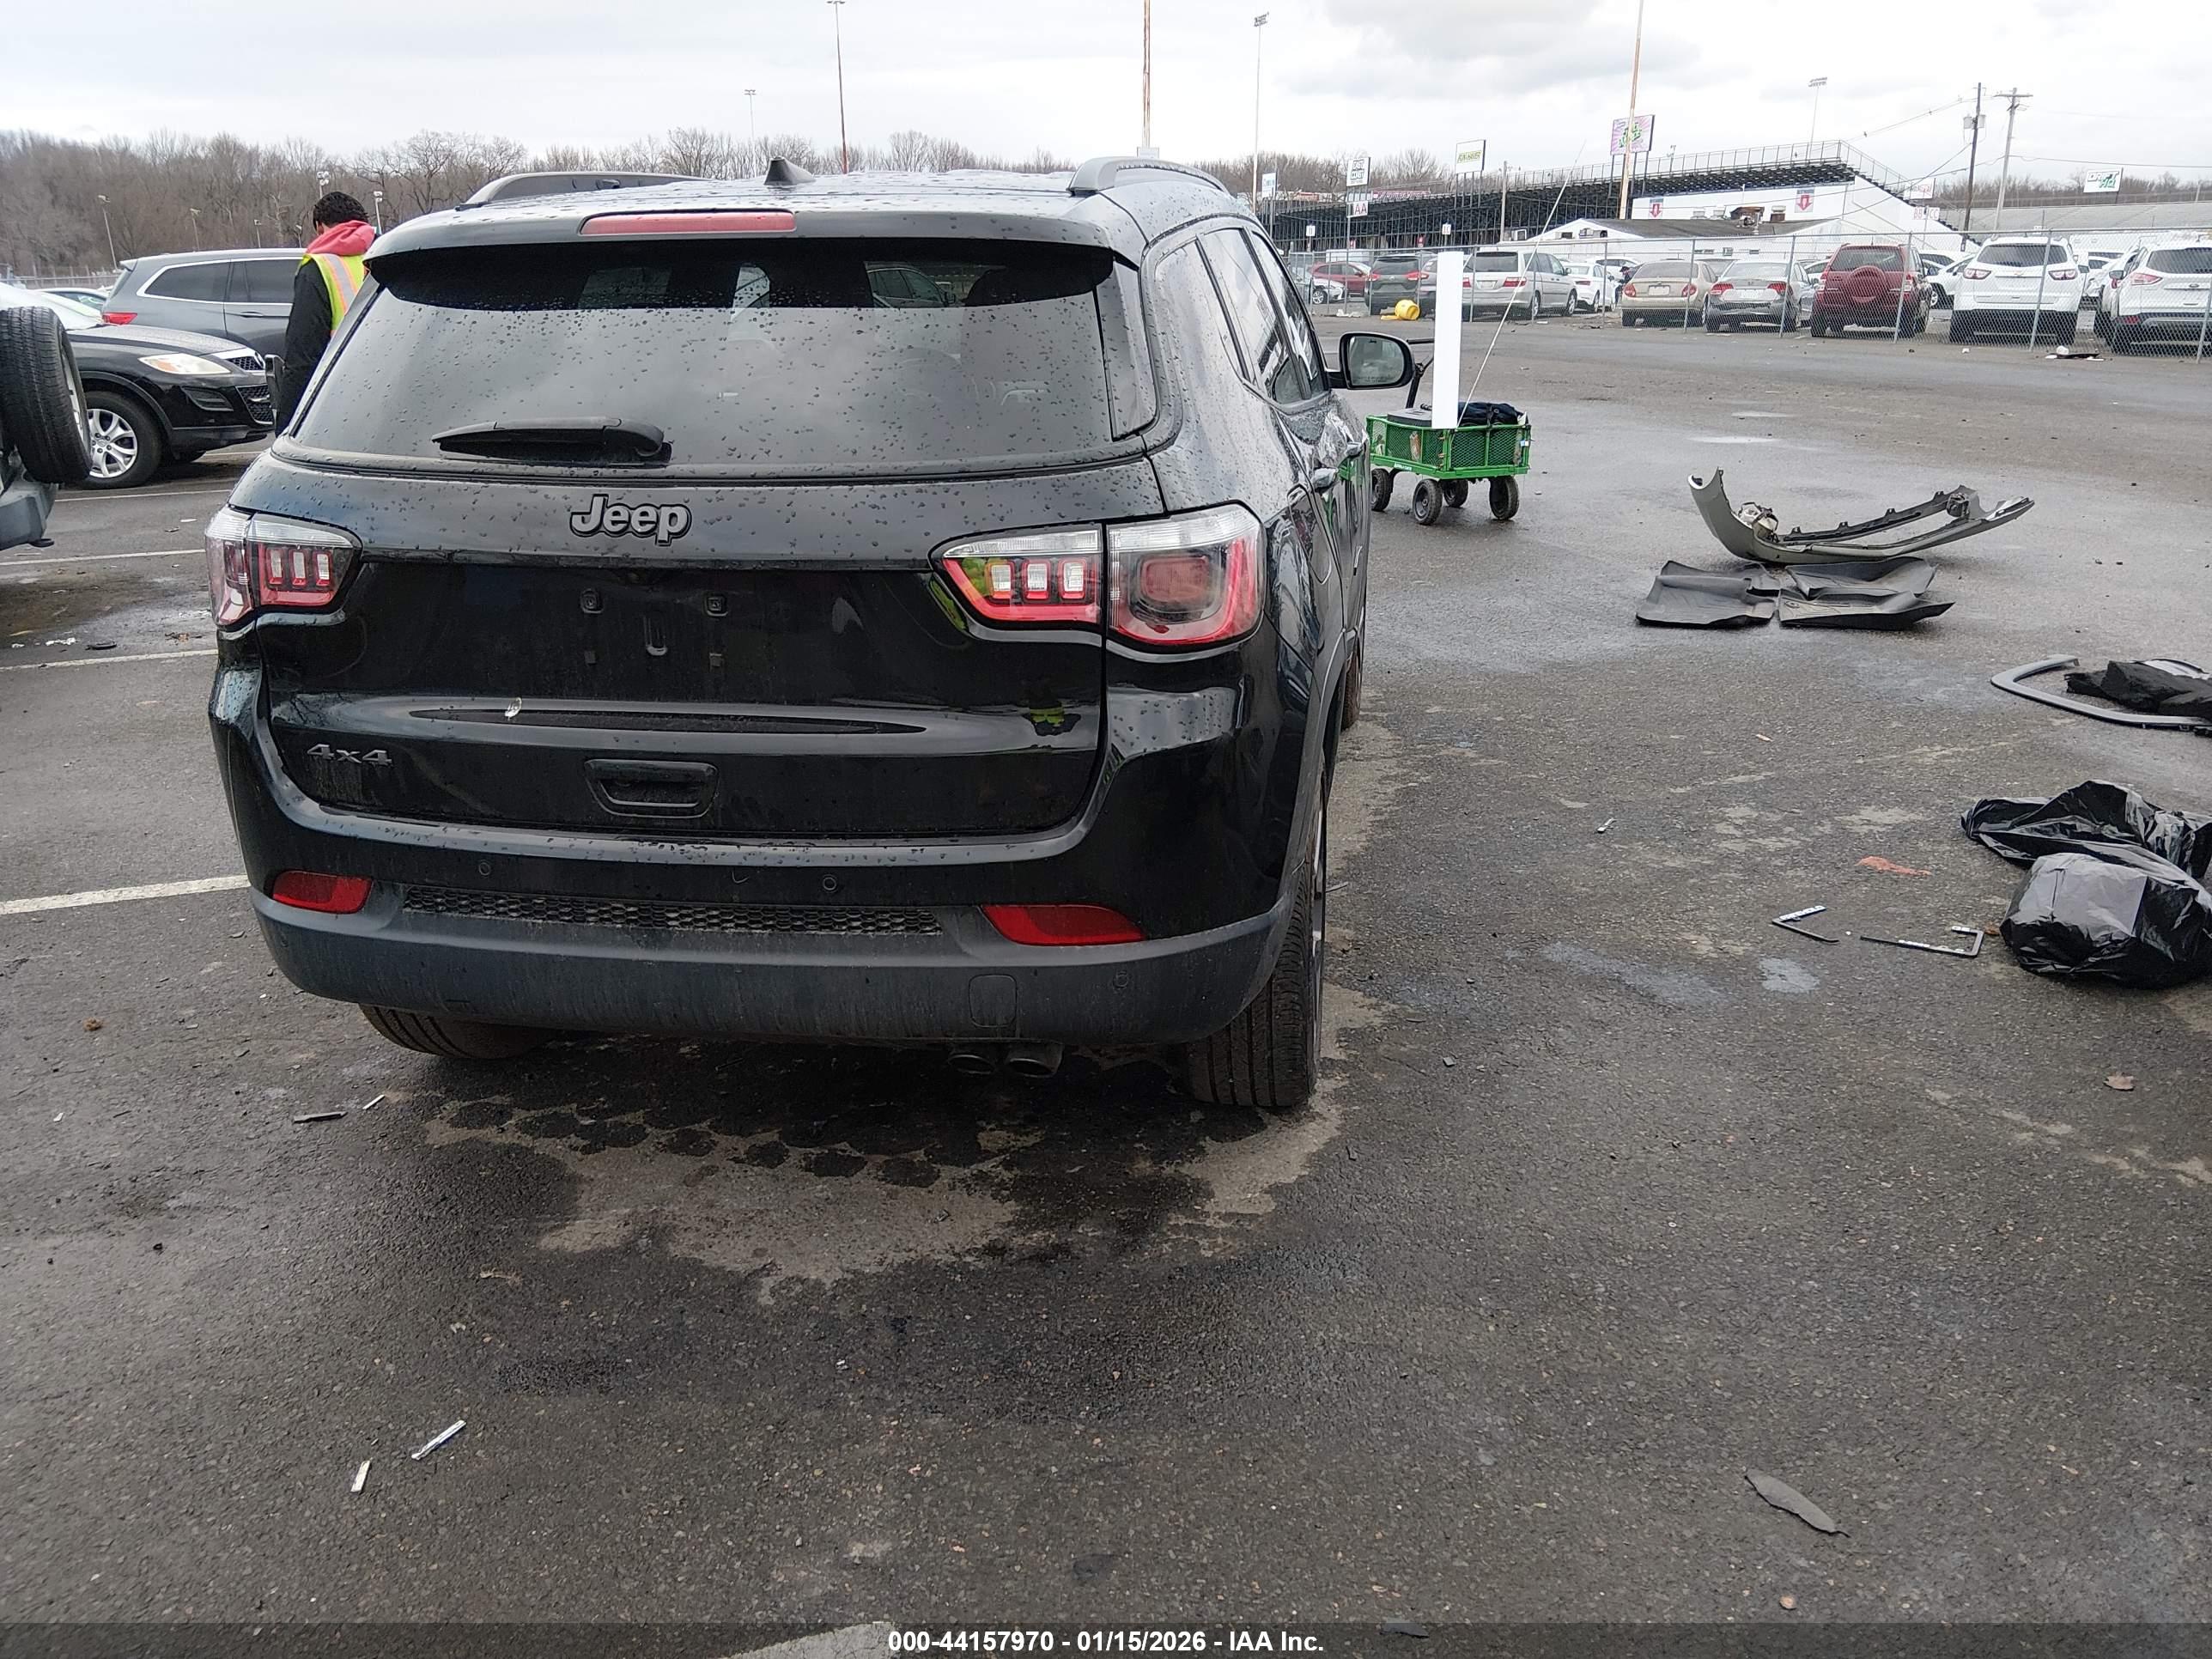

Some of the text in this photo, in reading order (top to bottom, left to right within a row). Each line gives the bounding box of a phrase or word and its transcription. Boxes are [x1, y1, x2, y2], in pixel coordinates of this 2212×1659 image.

[1355, 203, 1367, 215] AA
[570, 495, 690, 545] Jeep
[307, 744, 392, 766] 4x4
